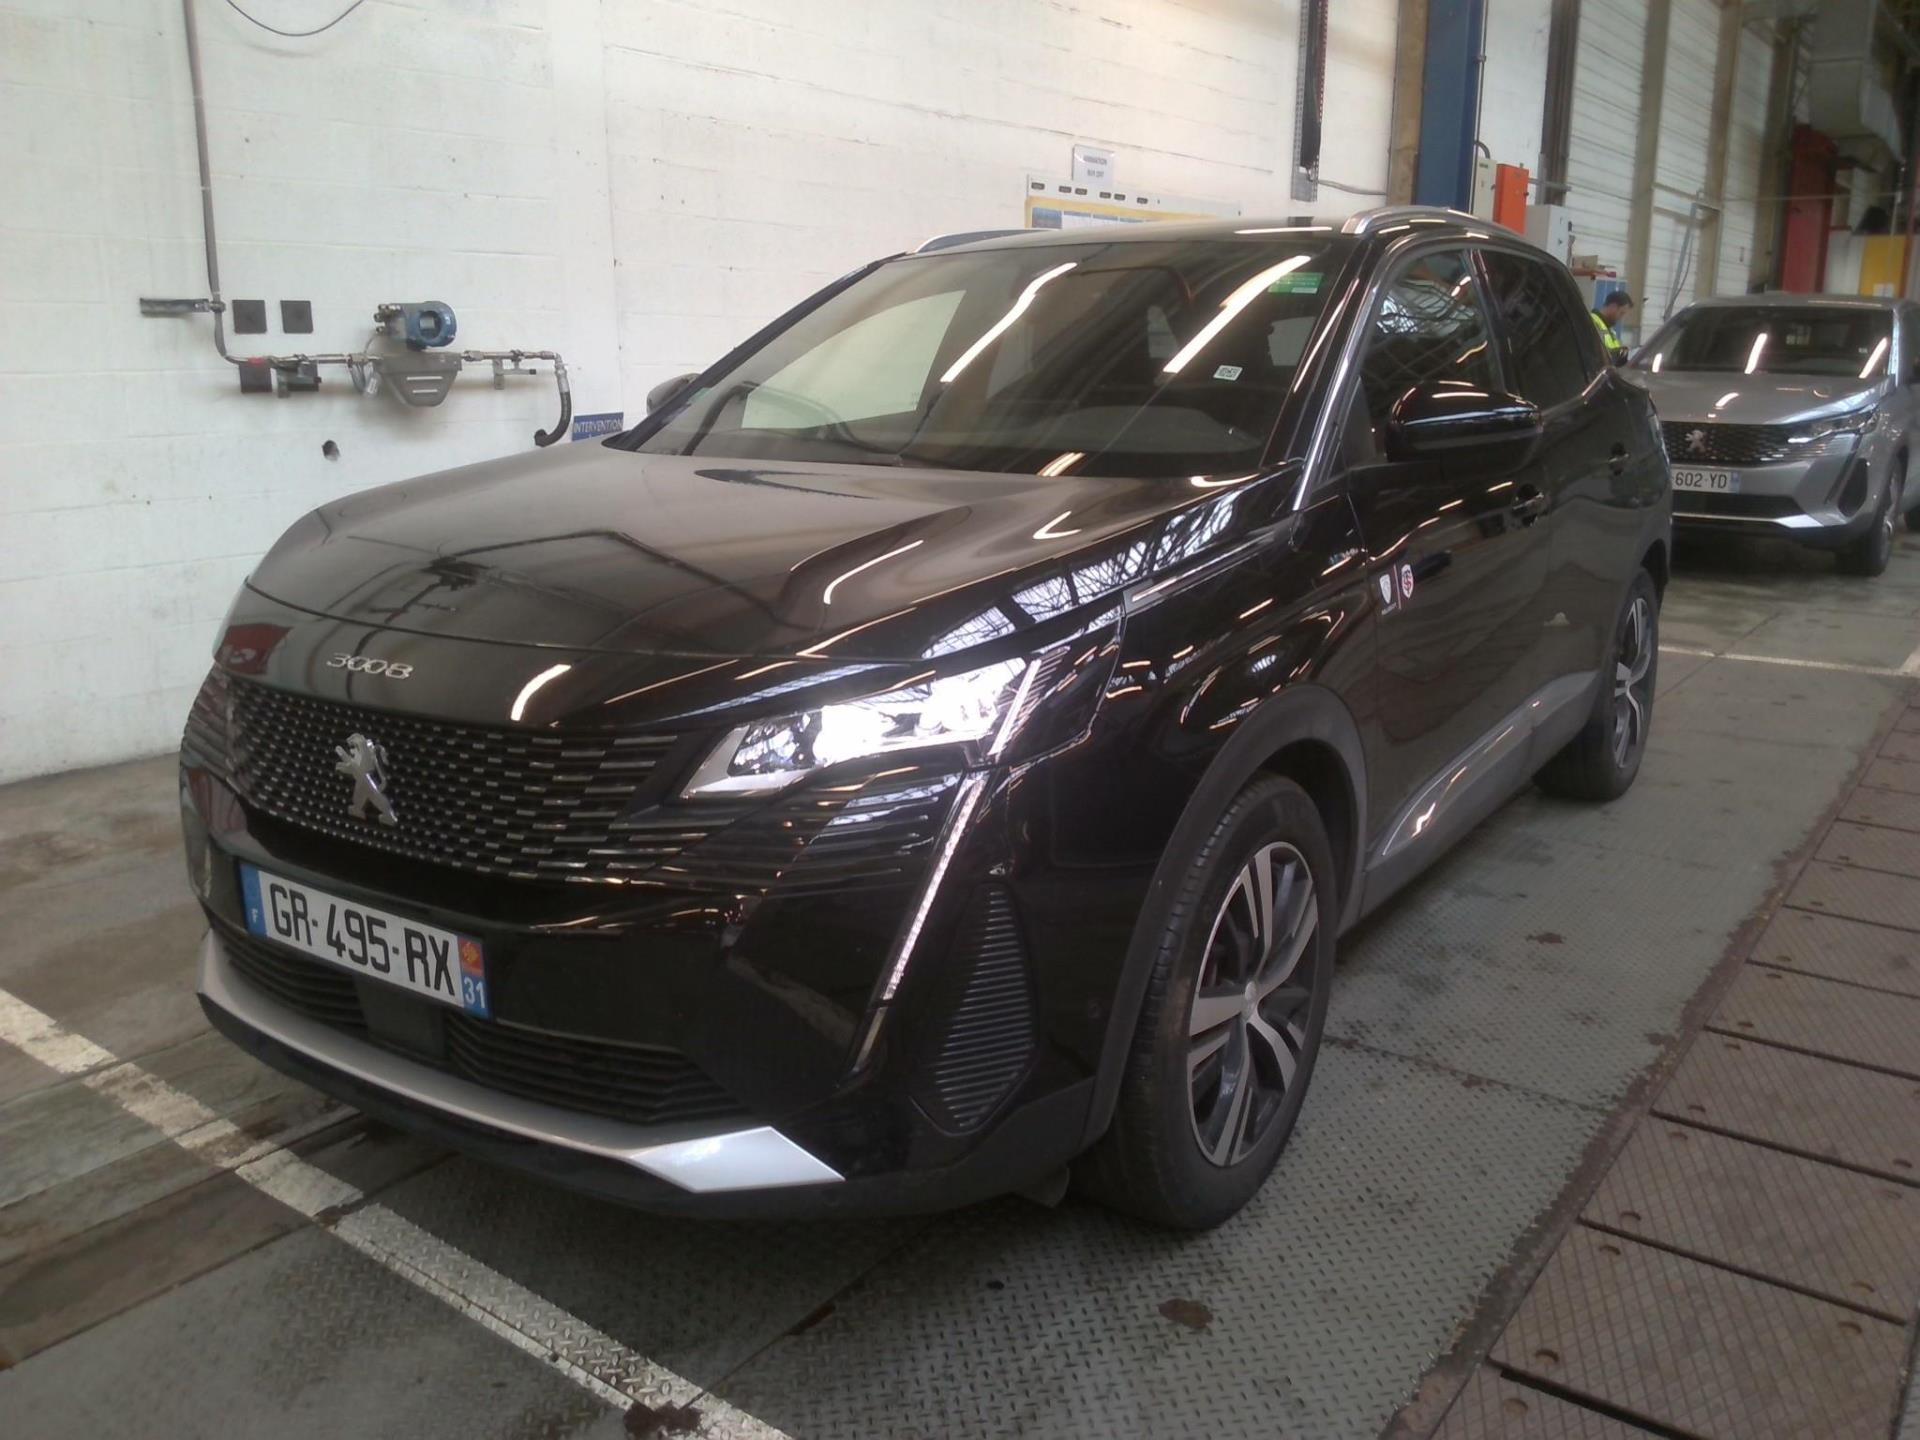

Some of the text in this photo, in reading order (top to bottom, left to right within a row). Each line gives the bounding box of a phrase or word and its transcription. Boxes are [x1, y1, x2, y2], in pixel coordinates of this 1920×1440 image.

[326, 652, 413, 679] 3008
[270, 883, 455, 996] GR-495-RX
[463, 976, 486, 1009] 31
